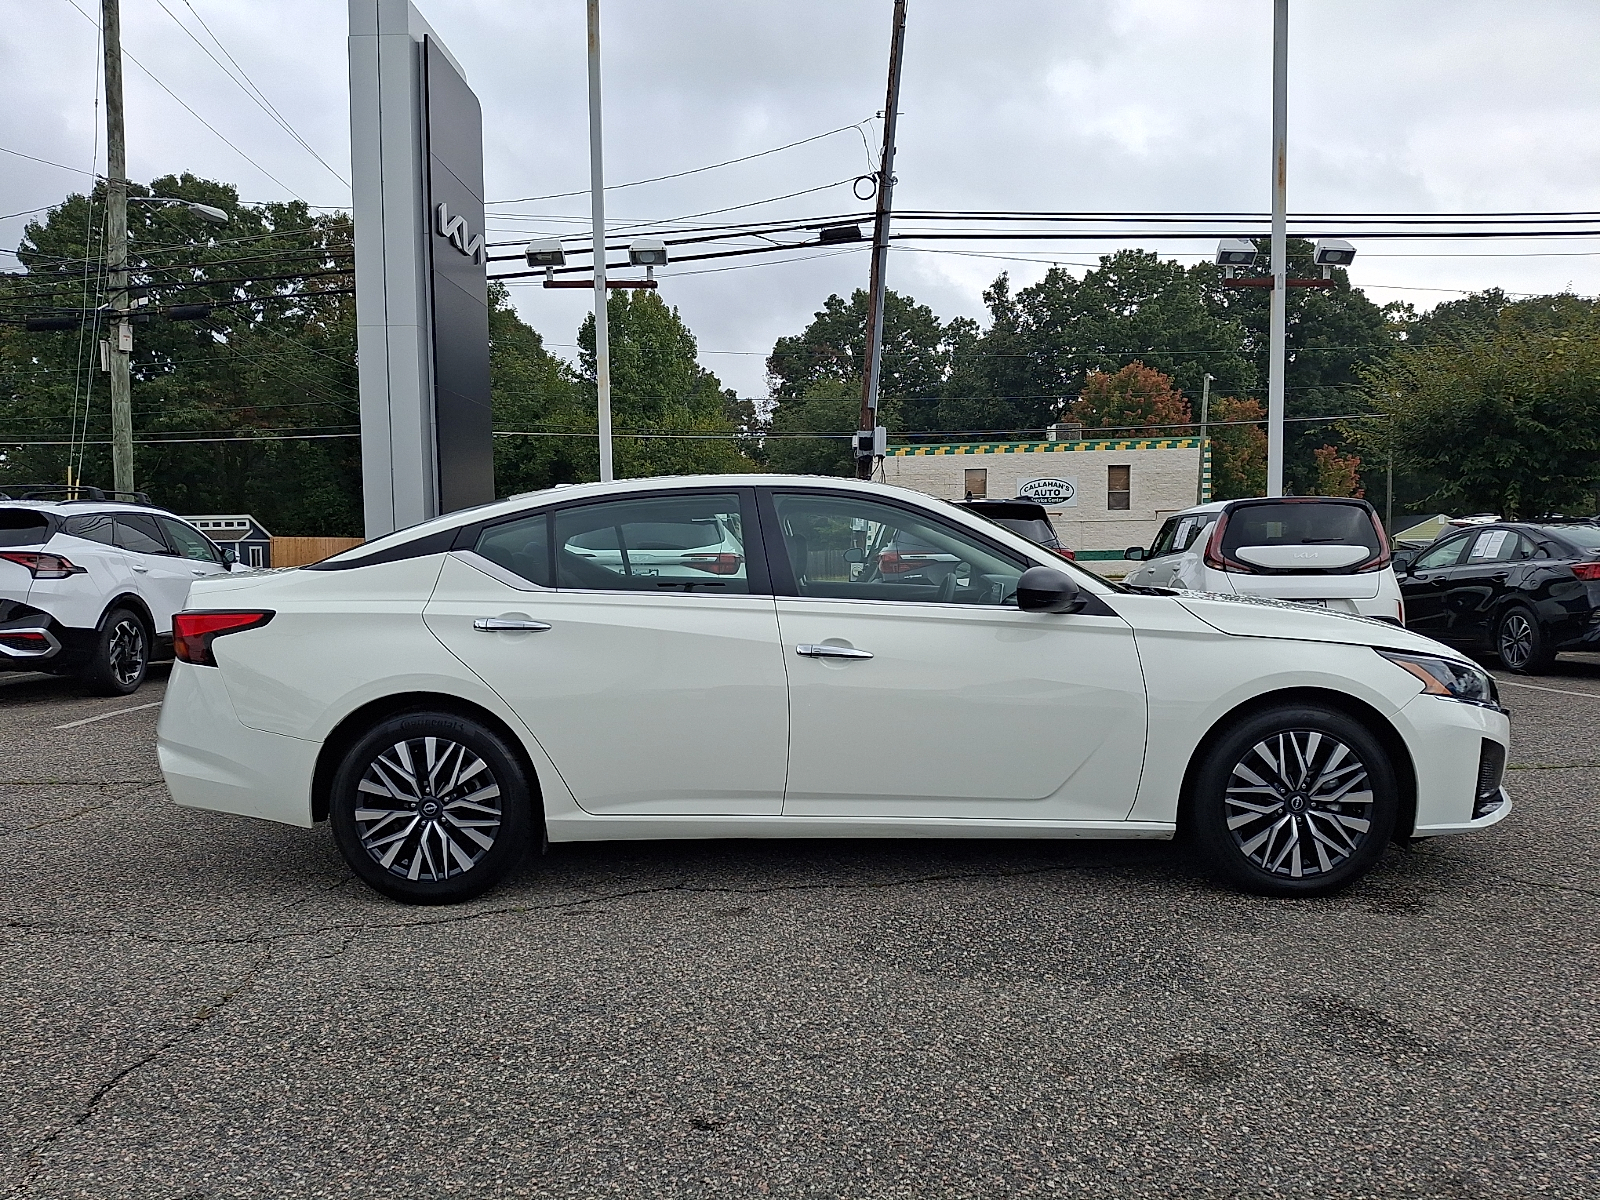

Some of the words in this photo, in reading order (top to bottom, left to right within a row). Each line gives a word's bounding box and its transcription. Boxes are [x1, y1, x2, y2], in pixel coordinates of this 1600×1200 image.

[438, 202, 486, 265] KIA
[1023, 481, 1070, 492] CALLAHAN'S
[1034, 489, 1061, 497] AUTO
